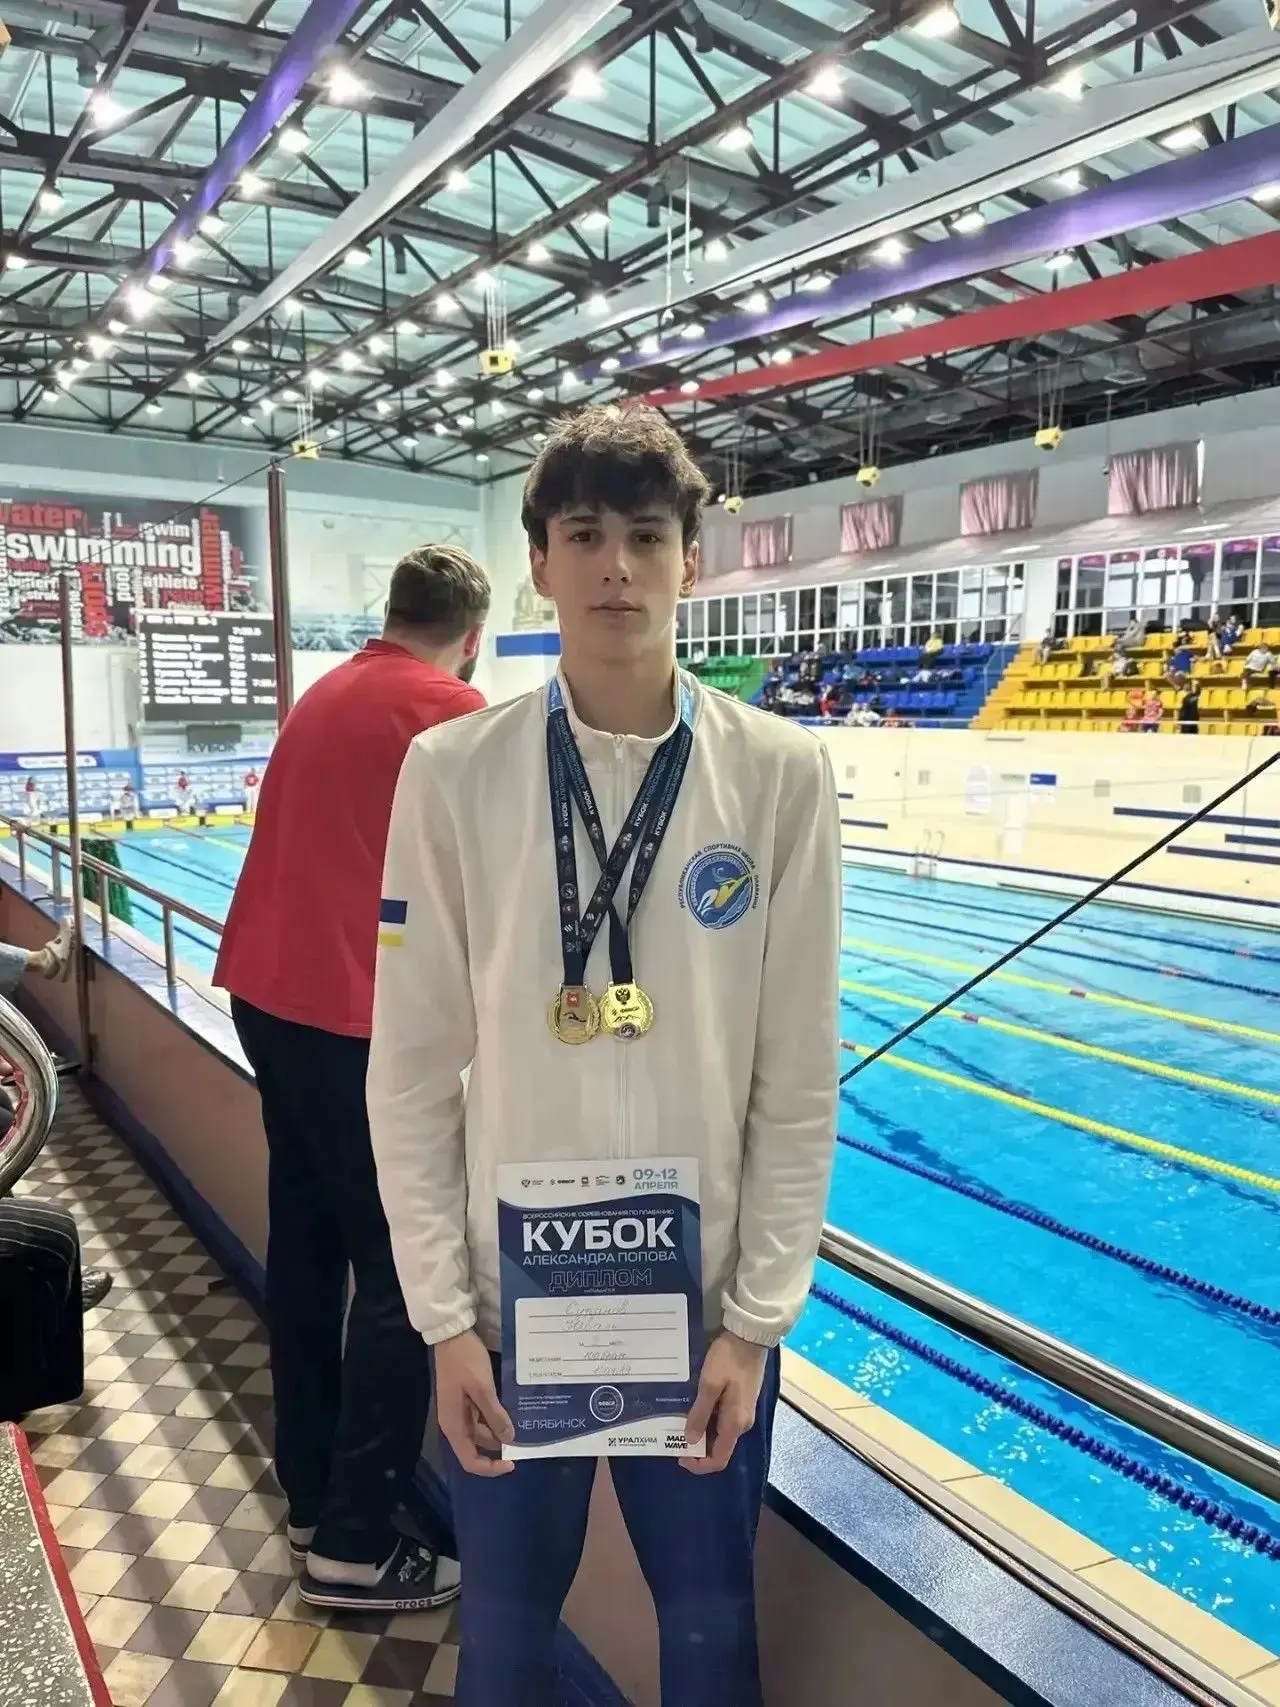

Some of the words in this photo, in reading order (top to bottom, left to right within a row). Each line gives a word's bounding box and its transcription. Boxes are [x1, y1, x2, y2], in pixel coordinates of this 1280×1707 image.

[6, 528, 201, 577] swimming
[111, 567, 135, 601] pool
[143, 573, 198, 590] athlete
[27, 590, 59, 600] strok
[583, 790, 595, 815] КУБОК
[561, 802, 569, 827] КУБОК
[634, 802, 649, 827] КУБОК
[655, 811, 668, 836] КУБОК
[703, 843, 741, 852] СПОРТИВНАЯ
[633, 1168, 678, 1181] 09-12
[634, 1181, 679, 1190] АПРЕЛЯ
[523, 1217, 676, 1252] КУБОК
[523, 1252, 615, 1266] АЛЕКСАНДРА
[618, 1251, 677, 1263] ПОПОВА
[549, 1268, 652, 1293] ДИПЛОМ
[518, 1418, 586, 1430] ЧЕЛЯБИНСК
[618, 1435, 657, 1444] УРАЛХИМ
[395, 1598, 433, 1609] crocs
